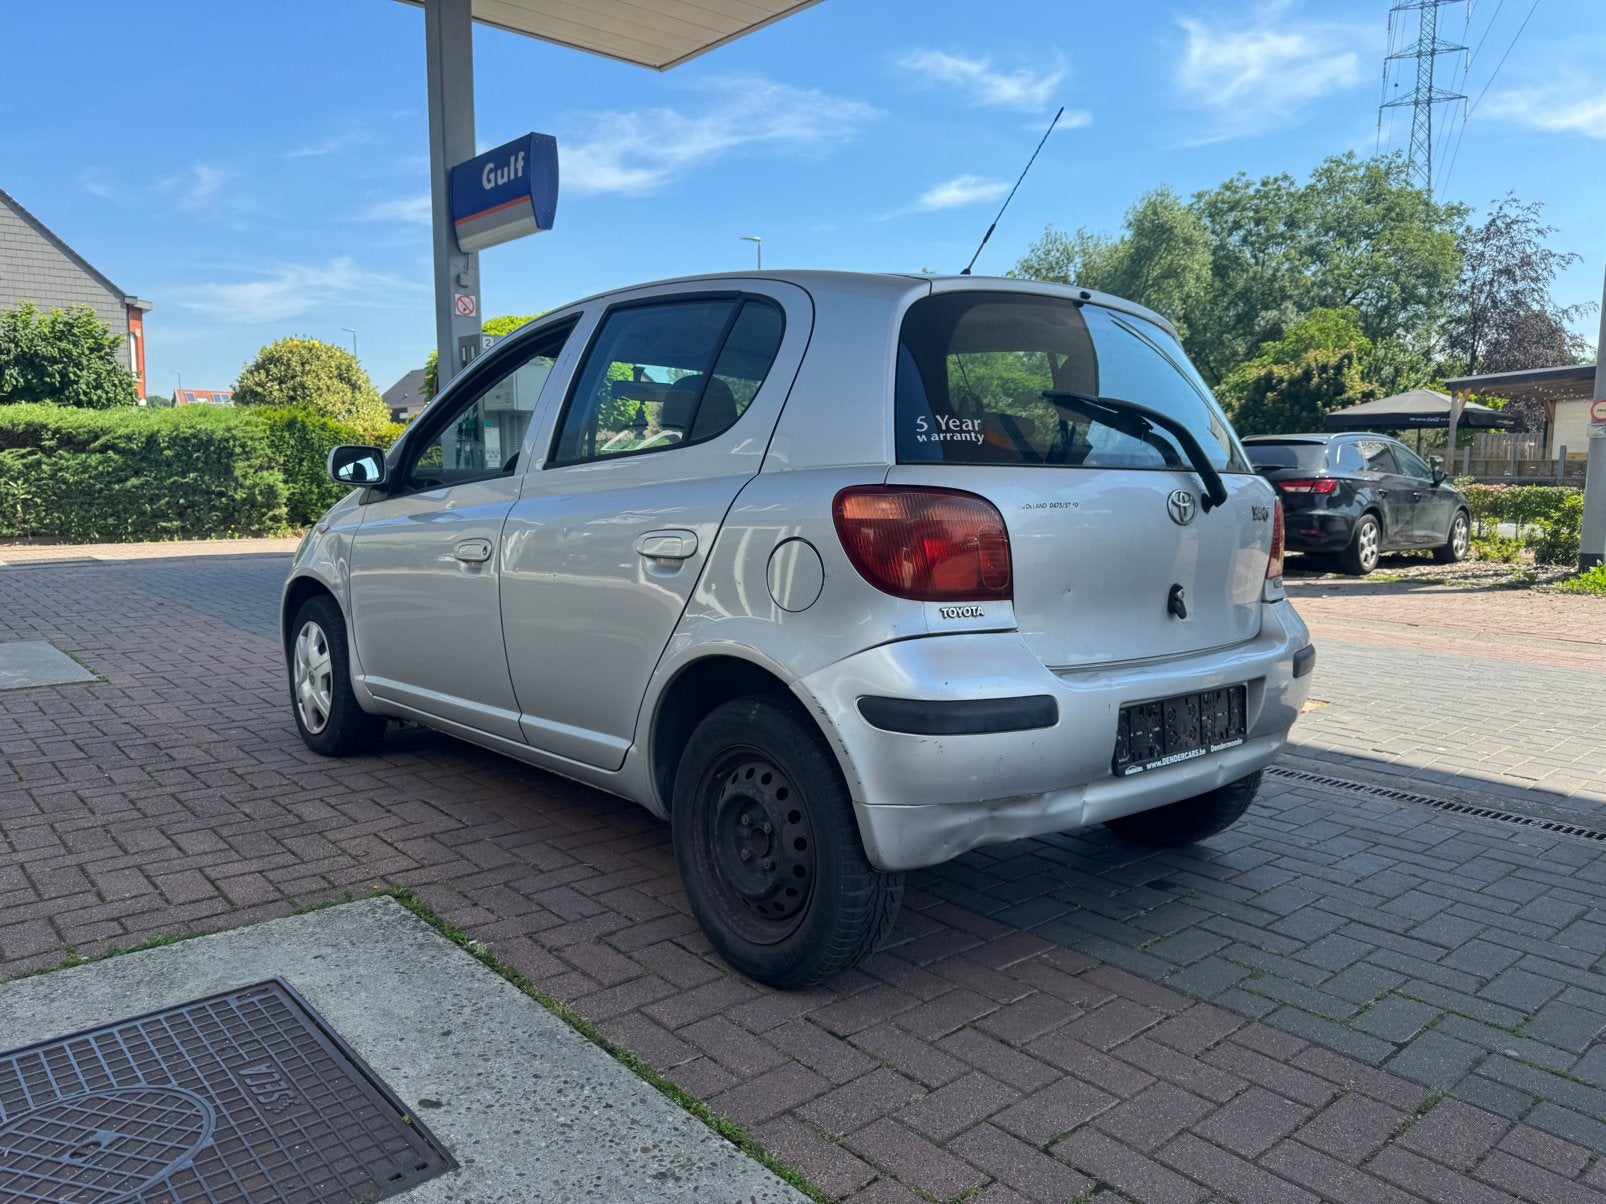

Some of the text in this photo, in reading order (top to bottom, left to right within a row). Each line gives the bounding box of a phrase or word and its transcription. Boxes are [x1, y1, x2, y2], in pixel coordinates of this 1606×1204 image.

[482, 151, 525, 190] Gulf
[485, 339, 491, 347] 2
[916, 414, 981, 432] 5 Year
[940, 606, 984, 619] TOYOTA
[1146, 748, 1206, 770] www.DENDERCARS.be
